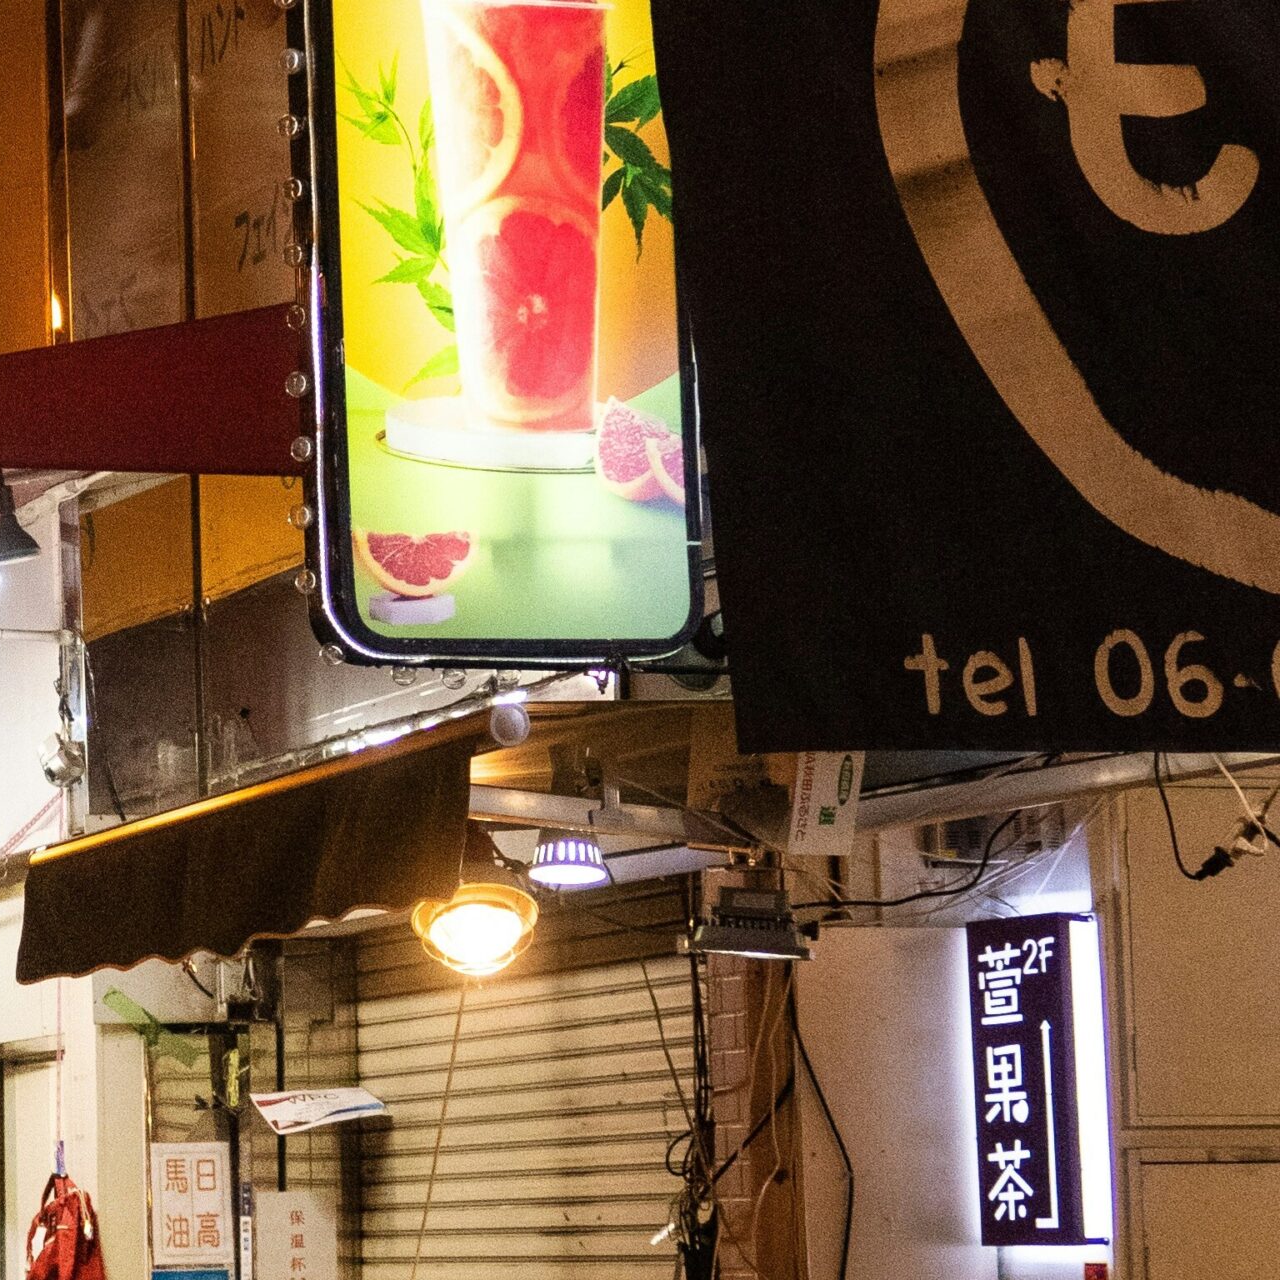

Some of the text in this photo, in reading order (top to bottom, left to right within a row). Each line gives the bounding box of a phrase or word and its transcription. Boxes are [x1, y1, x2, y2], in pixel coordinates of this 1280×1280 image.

[904, 628, 1280, 719] tel 06-
[1021, 936, 1055, 975] 2F
[977, 942, 1035, 1222] 萱果茶
